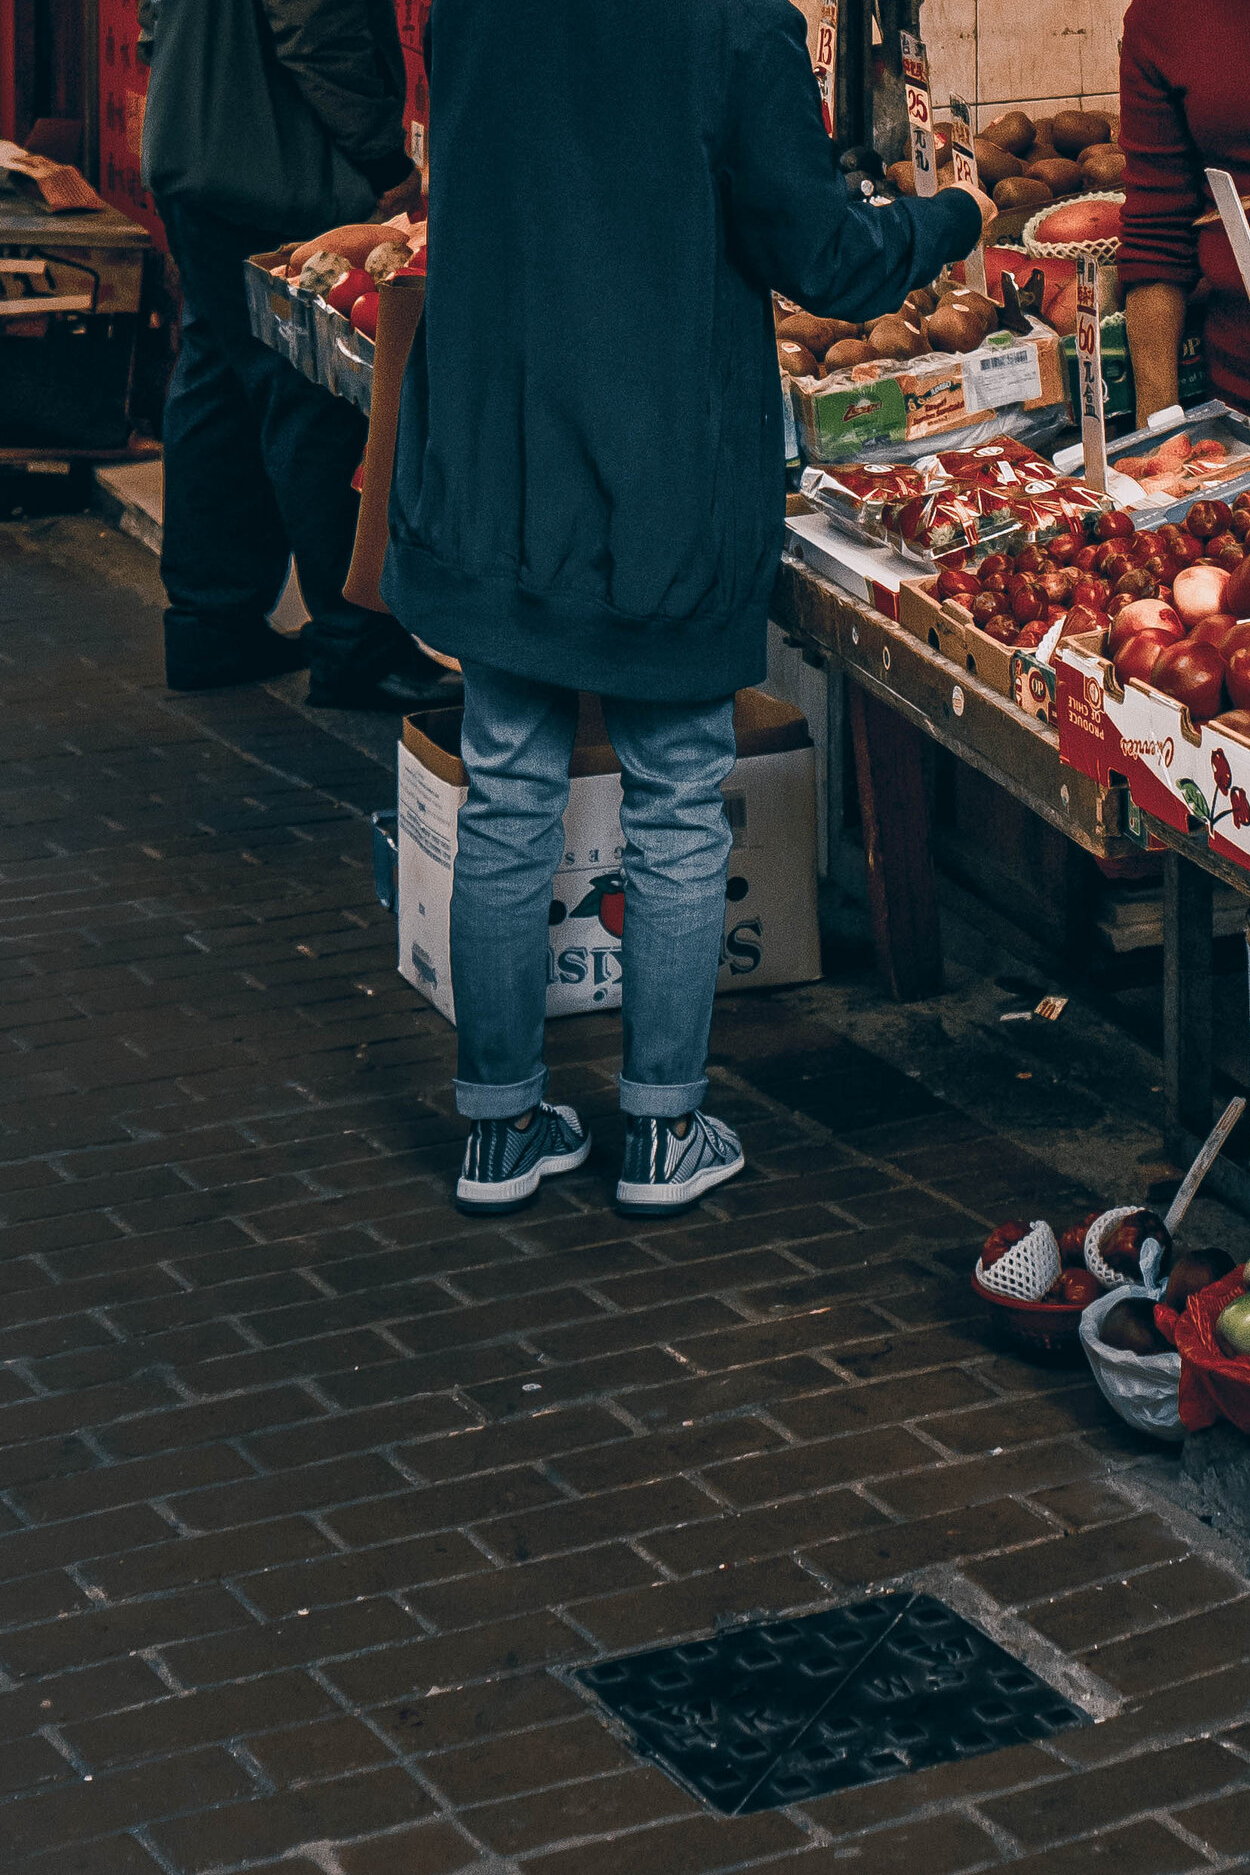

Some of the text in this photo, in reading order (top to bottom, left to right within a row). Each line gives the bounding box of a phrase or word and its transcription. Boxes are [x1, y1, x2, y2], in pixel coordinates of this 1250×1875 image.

[818, 28, 833, 66] 13
[908, 89, 928, 124] 25
[1079, 315, 1095, 355] 60
[1067, 695, 1090, 717] CHILE
[1068, 710, 1105, 741] PRODUCE
